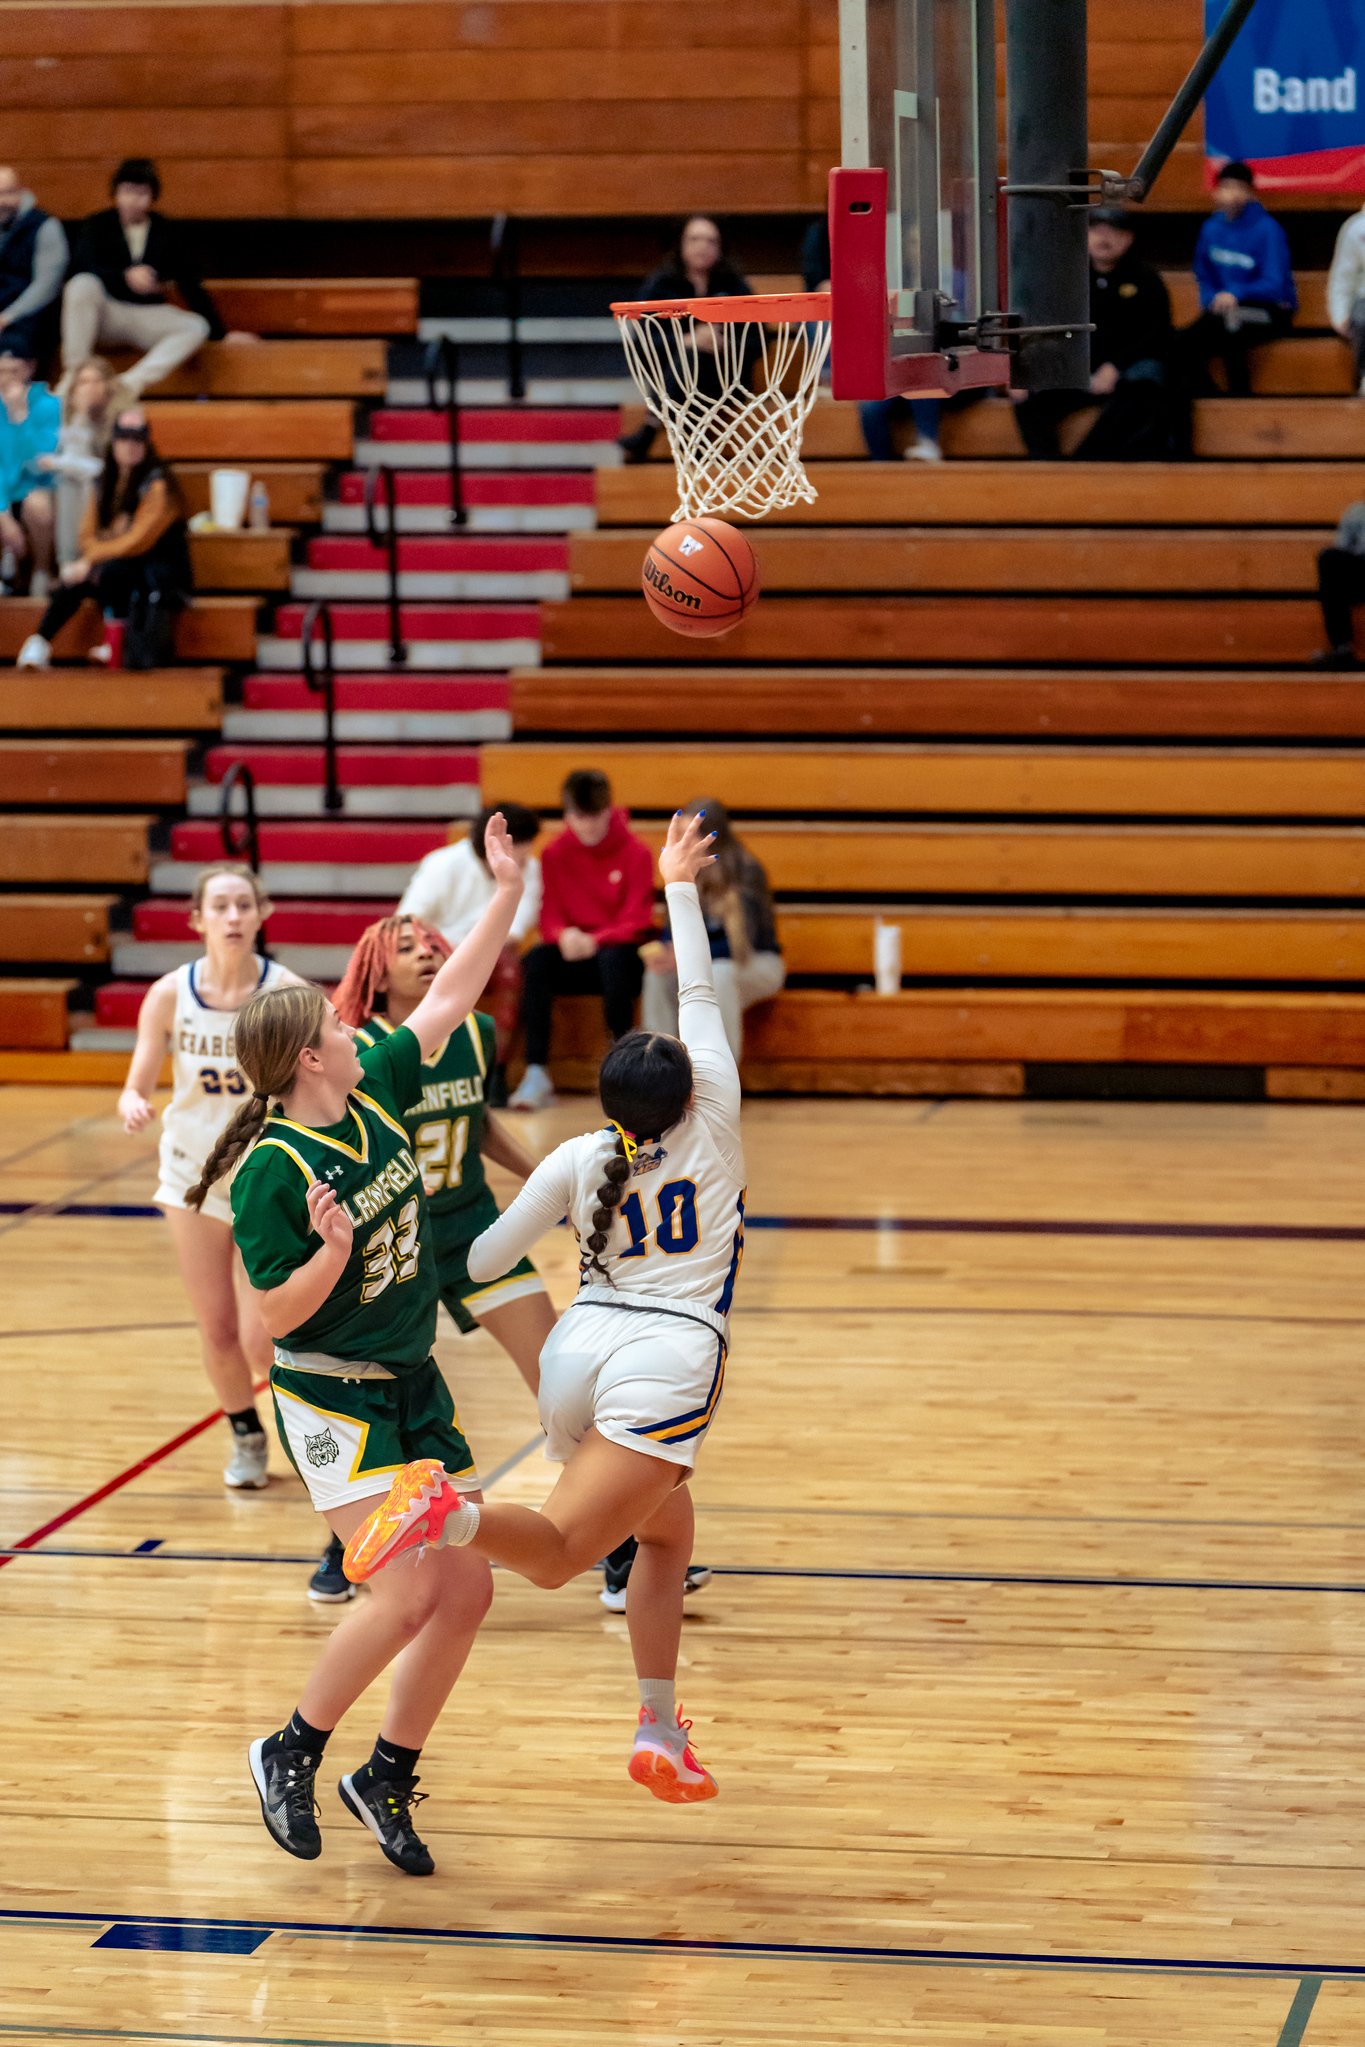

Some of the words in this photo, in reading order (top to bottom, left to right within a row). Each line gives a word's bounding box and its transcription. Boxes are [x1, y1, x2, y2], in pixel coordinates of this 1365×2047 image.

[1253, 67, 1356, 113] Band
[643, 555, 702, 610] Wilson
[415, 1115, 470, 1189] 21
[360, 1194, 421, 1304] 33
[617, 1176, 701, 1259] 10
